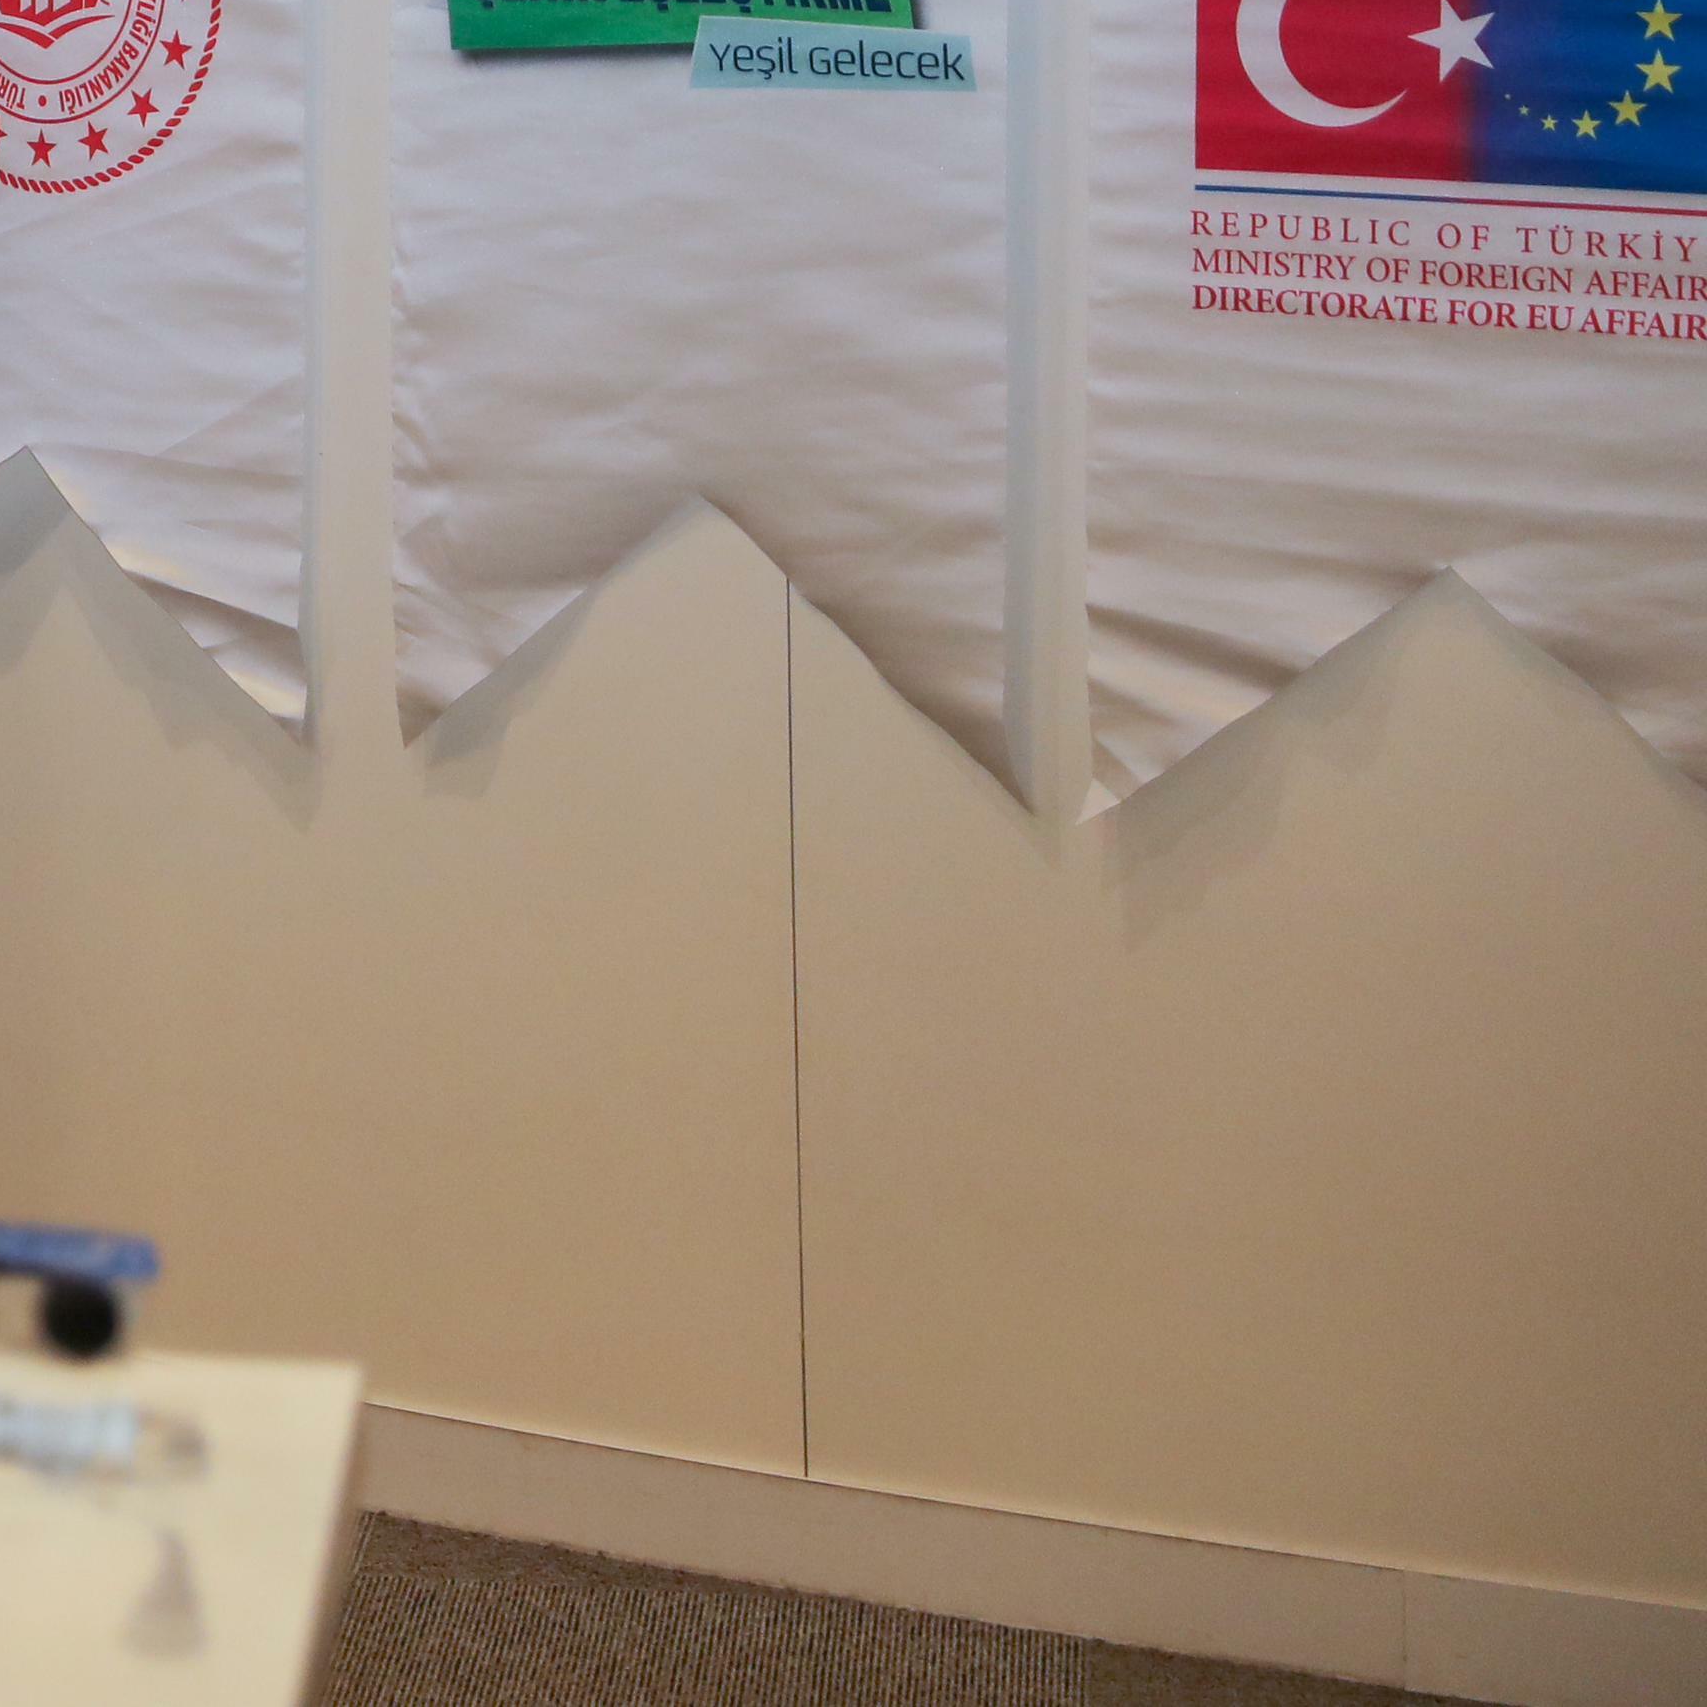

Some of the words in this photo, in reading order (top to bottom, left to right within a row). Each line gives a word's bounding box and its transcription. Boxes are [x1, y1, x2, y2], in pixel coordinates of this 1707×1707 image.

[710, 37, 798, 80] Yeşil
[809, 40, 964, 80] Gelecek
[1191, 211, 1409, 246] REPUBLIC
[1437, 223, 1489, 250] OF
[1193, 248, 1355, 280] MINISTRY
[1366, 257, 1409, 283] OF
[1420, 260, 1573, 293] FOREIGN
[1193, 284, 1437, 323] DIRECTORATE
[1448, 299, 1518, 329] FOR
[1527, 304, 1574, 332] EU
